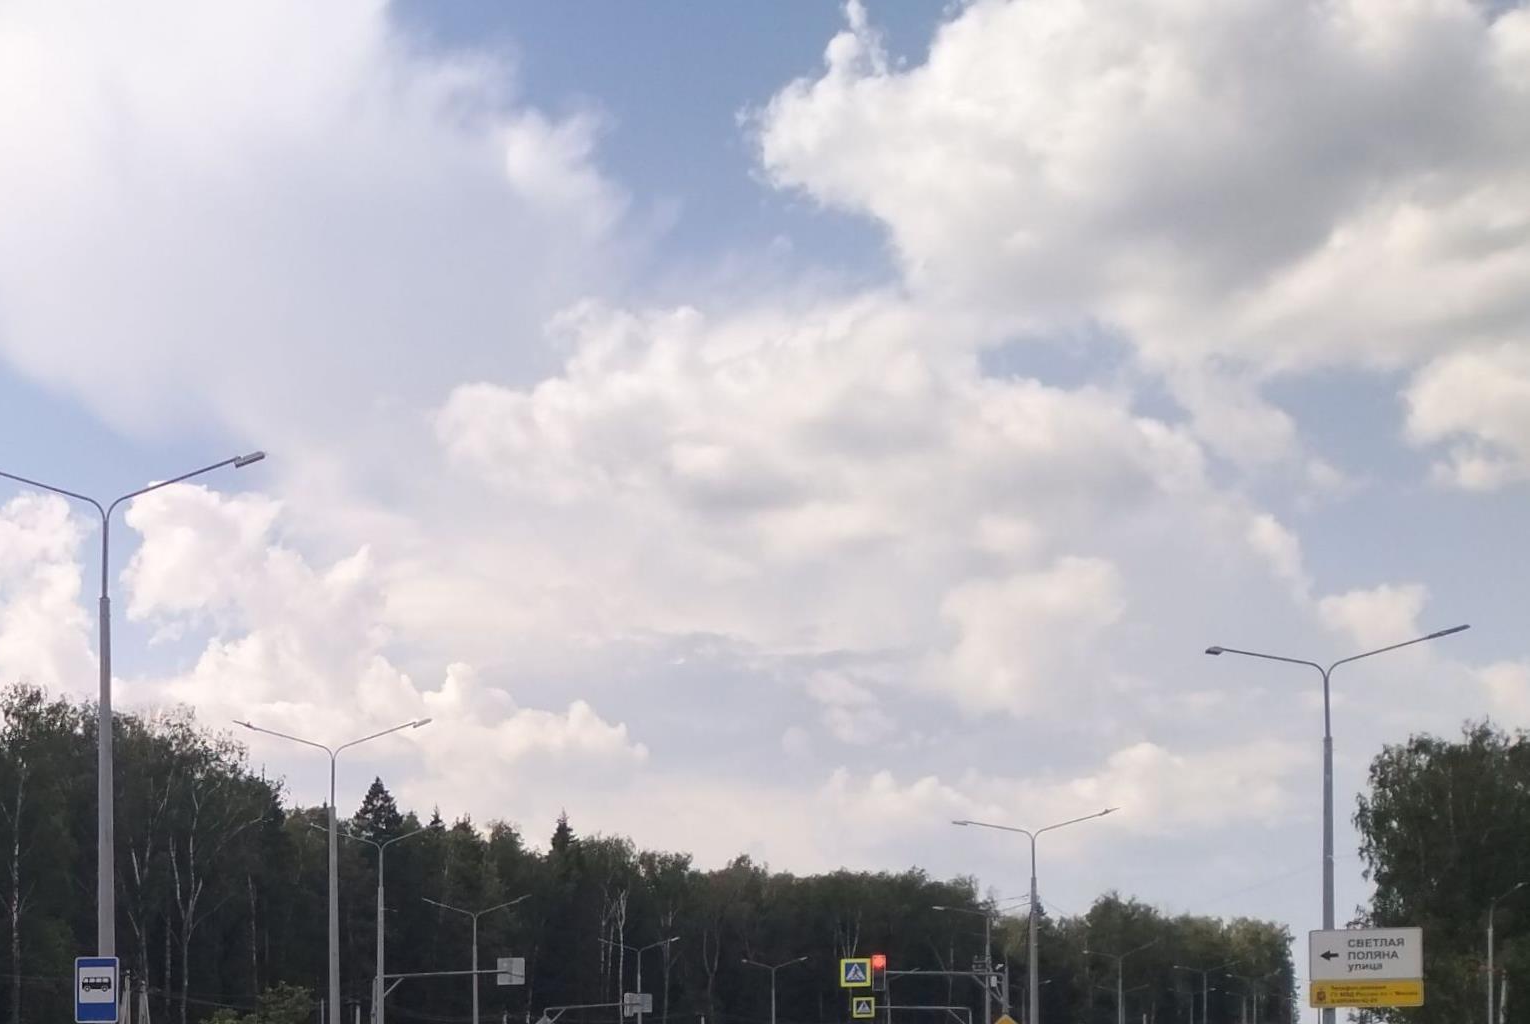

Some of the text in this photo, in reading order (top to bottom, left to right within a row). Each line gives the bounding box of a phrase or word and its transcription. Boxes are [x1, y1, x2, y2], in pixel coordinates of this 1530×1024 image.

[1348, 937, 1405, 948] СВЕТЛАЯ
[1348, 950, 1399, 960] ПОЛЯНА
[1348, 963, 1383, 973] улица
